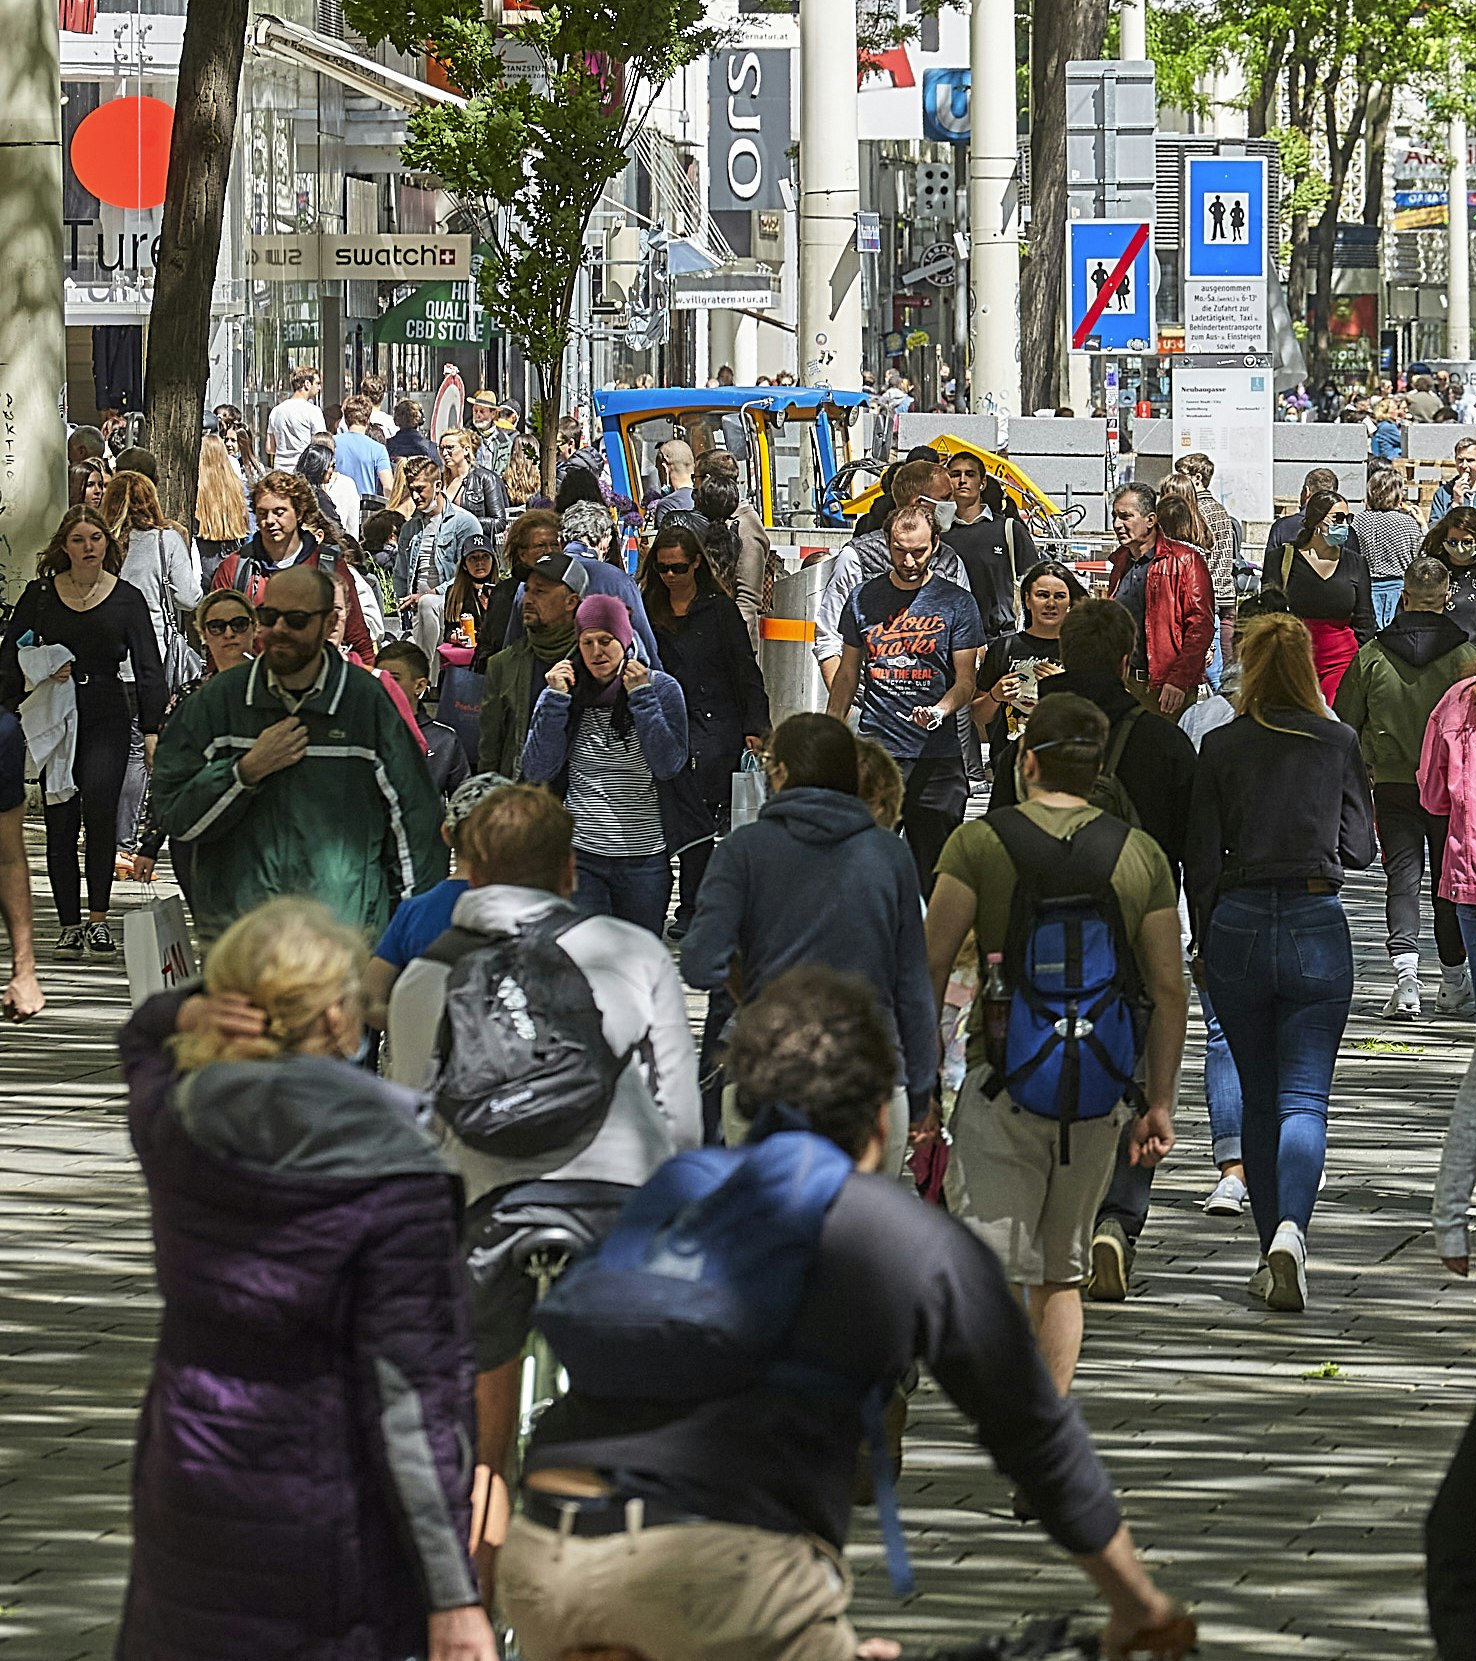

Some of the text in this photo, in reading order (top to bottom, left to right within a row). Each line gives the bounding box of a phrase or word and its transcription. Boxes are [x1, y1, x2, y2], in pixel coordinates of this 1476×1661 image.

[336, 245, 436, 265] swatch
[1201, 285, 1251, 293] ausgenommen
[425, 301, 484, 320] QUALIY
[406, 320, 434, 338] CBD
[1227, 333, 1261, 341] Einsteigen
[1181, 386, 1226, 394] Neubaugasse
[894, 669, 910, 679] THE
[911, 669, 933, 679] REAL
